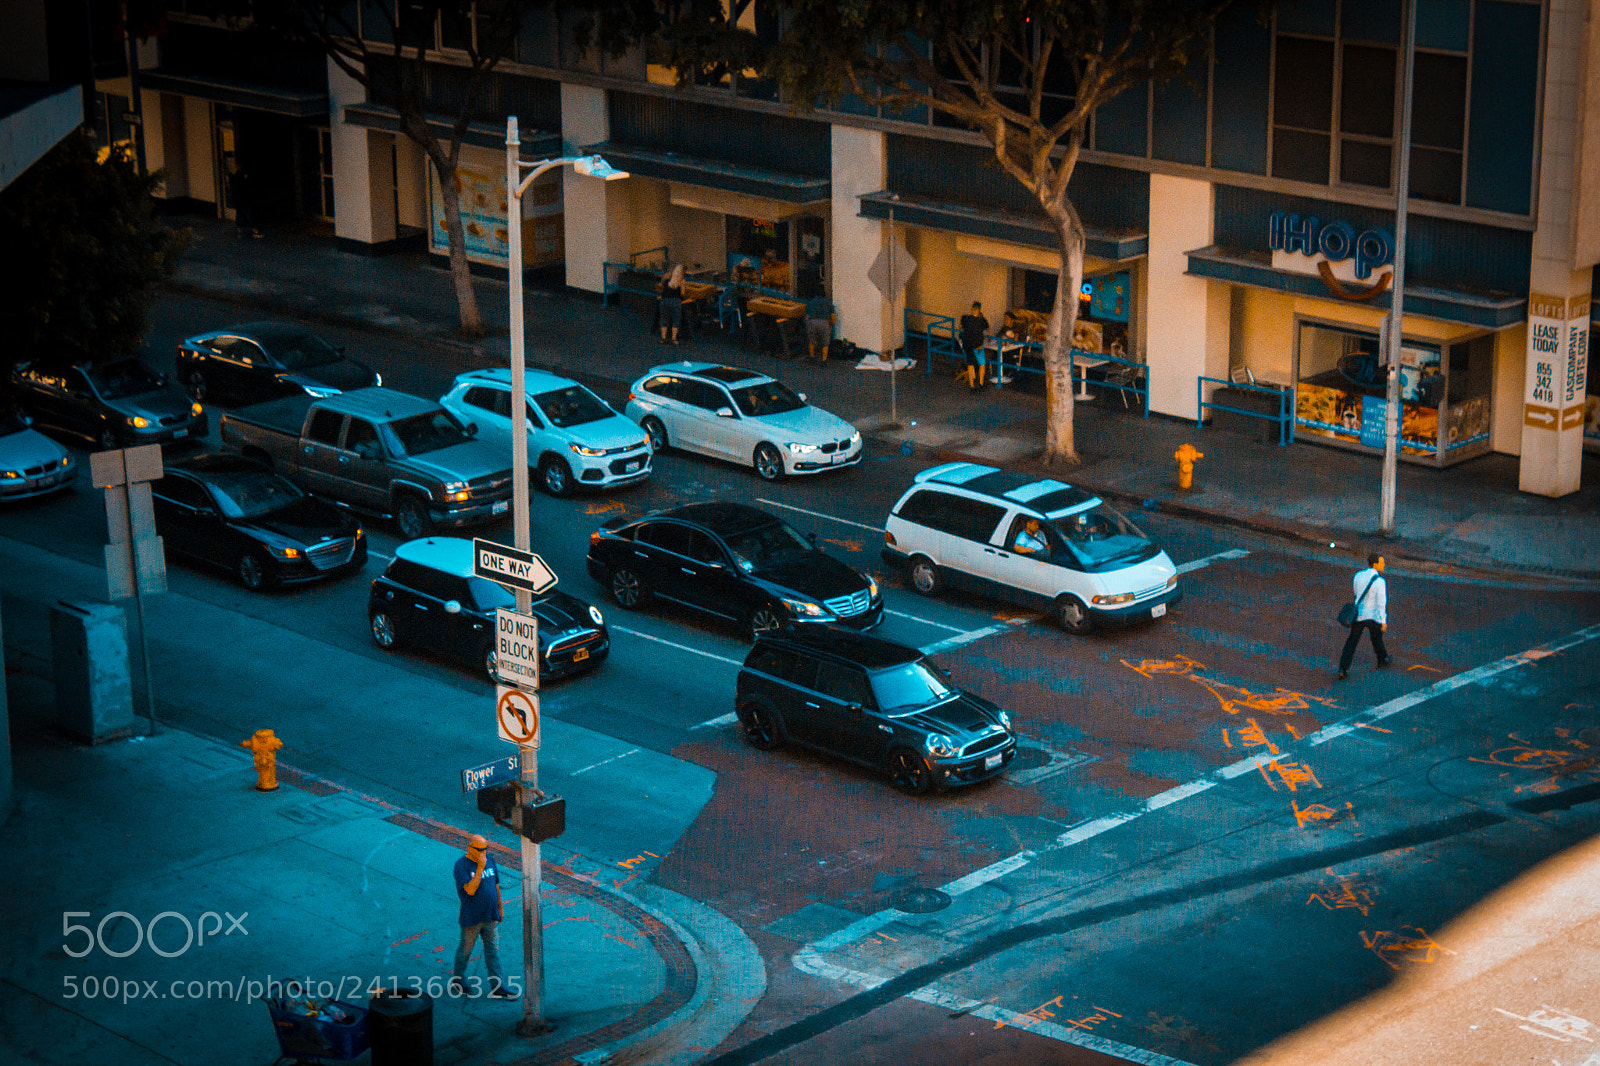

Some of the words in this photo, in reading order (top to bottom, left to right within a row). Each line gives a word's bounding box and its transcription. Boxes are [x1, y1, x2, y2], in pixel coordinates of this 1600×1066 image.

[1533, 323, 1559, 341] LEASE
[1532, 337, 1559, 354] TODAY
[1536, 362, 1552, 376] 855
[1565, 326, 1578, 402] GASCOMPANY
[1536, 375, 1552, 389] 342
[1532, 387, 1554, 403] 4418
[482, 553, 505, 571] ONE
[508, 560, 531, 578] WAY
[500, 616, 513, 634] DO
[516, 621, 534, 640] NOT
[500, 637, 535, 662] BLOCK
[499, 659, 536, 678] INTERSECTION
[466, 766, 495, 784] Flower
[508, 757, 518, 770] St
